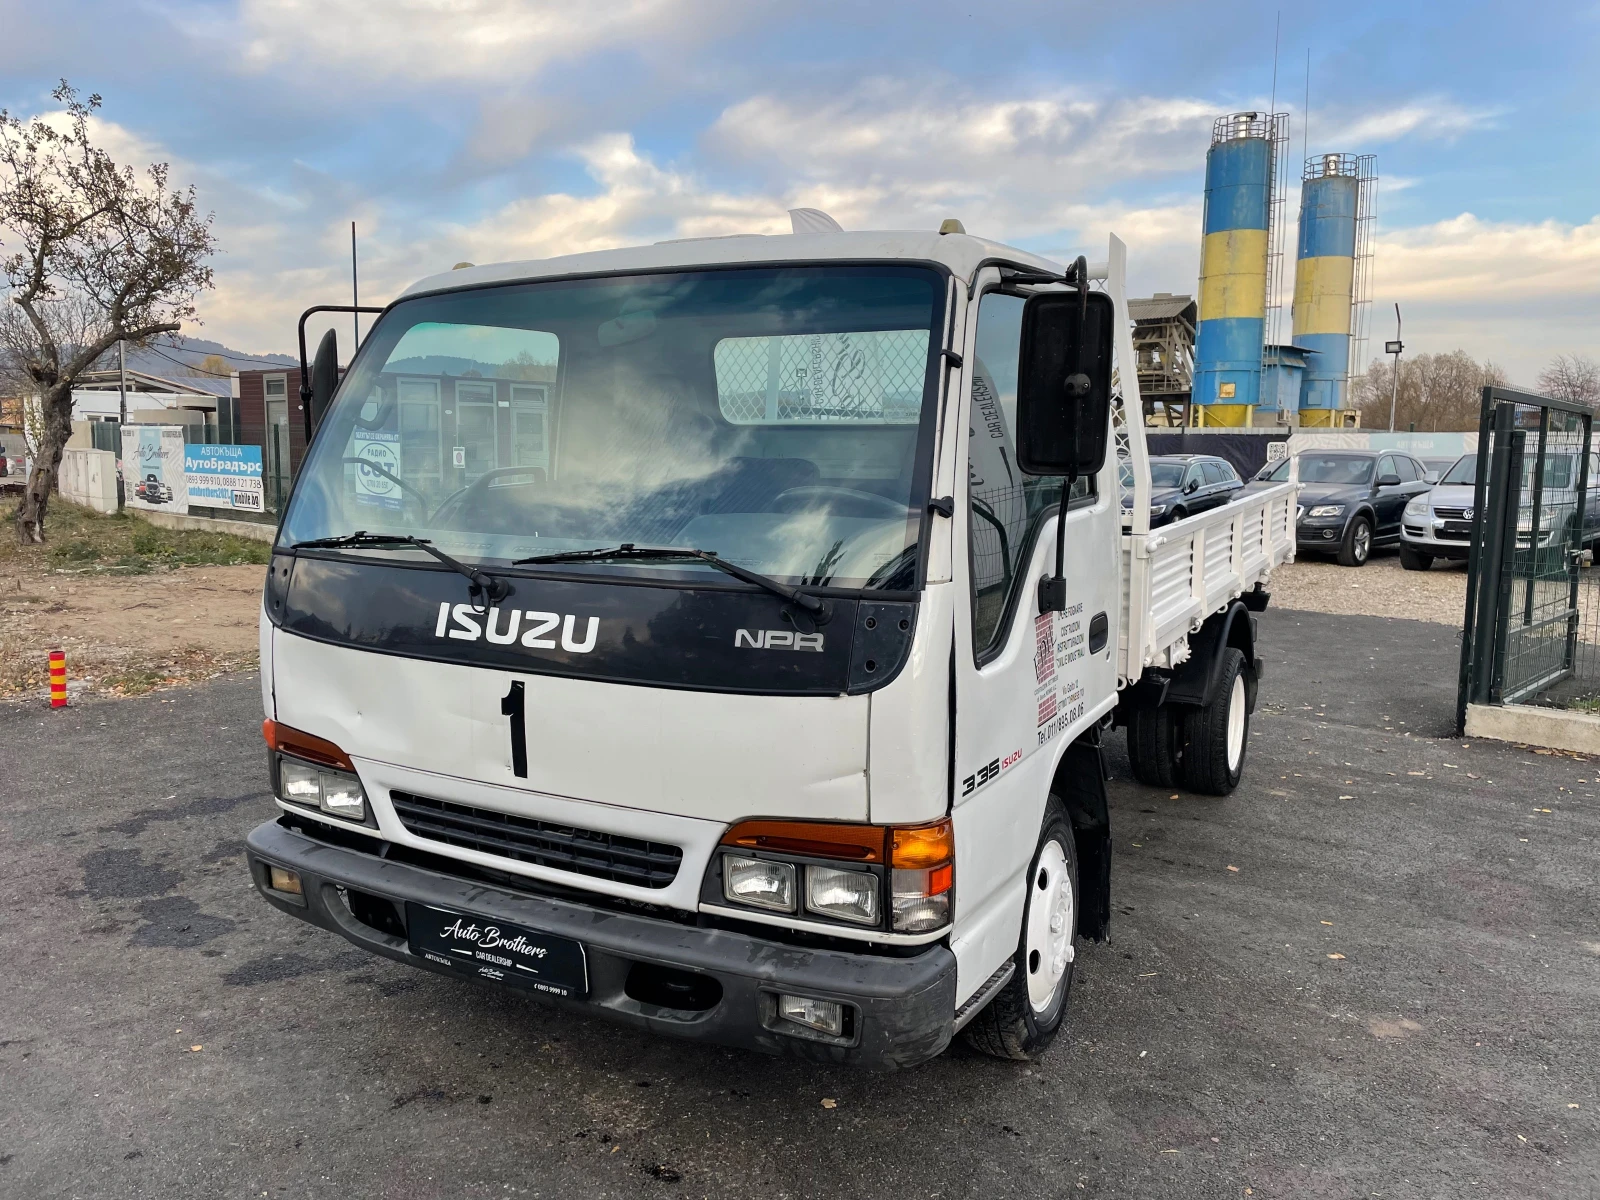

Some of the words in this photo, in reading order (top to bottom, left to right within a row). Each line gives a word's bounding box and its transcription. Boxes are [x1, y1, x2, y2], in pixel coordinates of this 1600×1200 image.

[987, 421, 1004, 439] CAR
[201, 446, 242, 458] АВТОКЪЩА
[367, 448, 387, 457] РАДИО
[185, 457, 262, 474] АутоБрадърс
[199, 475, 210, 485] 999
[435, 602, 600, 653] ISUZU
[734, 628, 824, 652] NPR
[501, 680, 528, 778] 1
[1001, 748, 1022, 770] ISUZU
[439, 919, 481, 942] Auto
[478, 926, 548, 959] Brothers
[475, 950, 485, 960] CAR
[486, 952, 513, 967] DEALERSHIP
